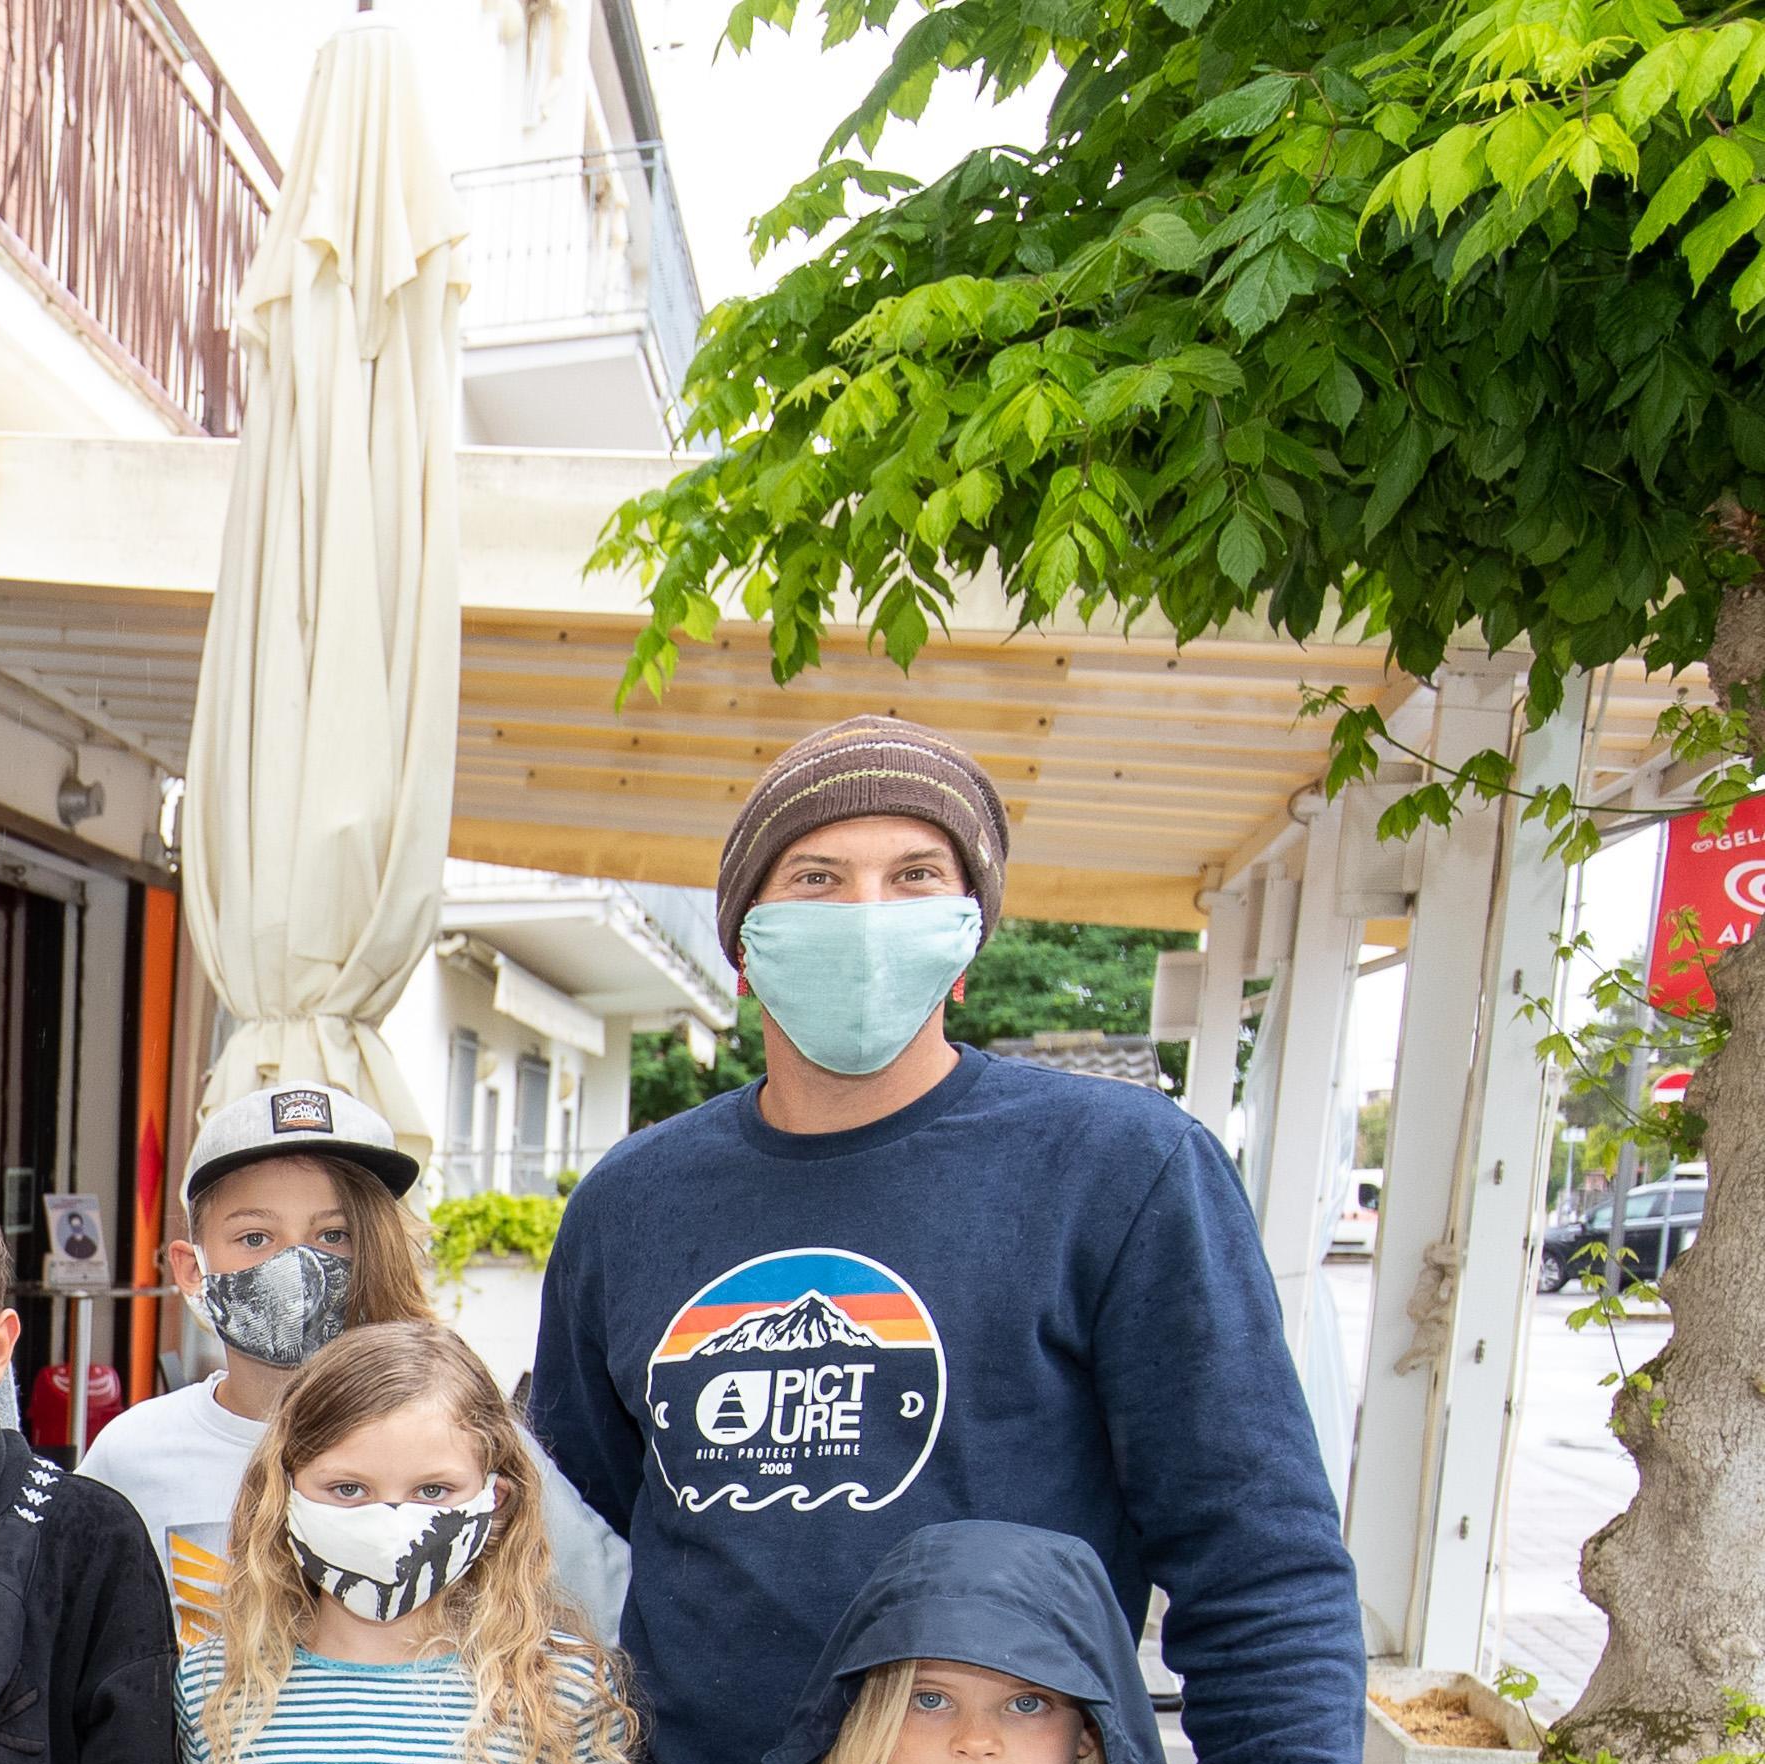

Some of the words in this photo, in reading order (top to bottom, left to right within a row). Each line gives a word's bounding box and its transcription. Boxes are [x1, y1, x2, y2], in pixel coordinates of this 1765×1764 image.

[774, 1364, 876, 1407] PICT
[771, 1401, 863, 1444] URE
[737, 1446, 797, 1460] PROTECT
[817, 1444, 861, 1457] SHARE
[758, 1462, 793, 1475] 2008
